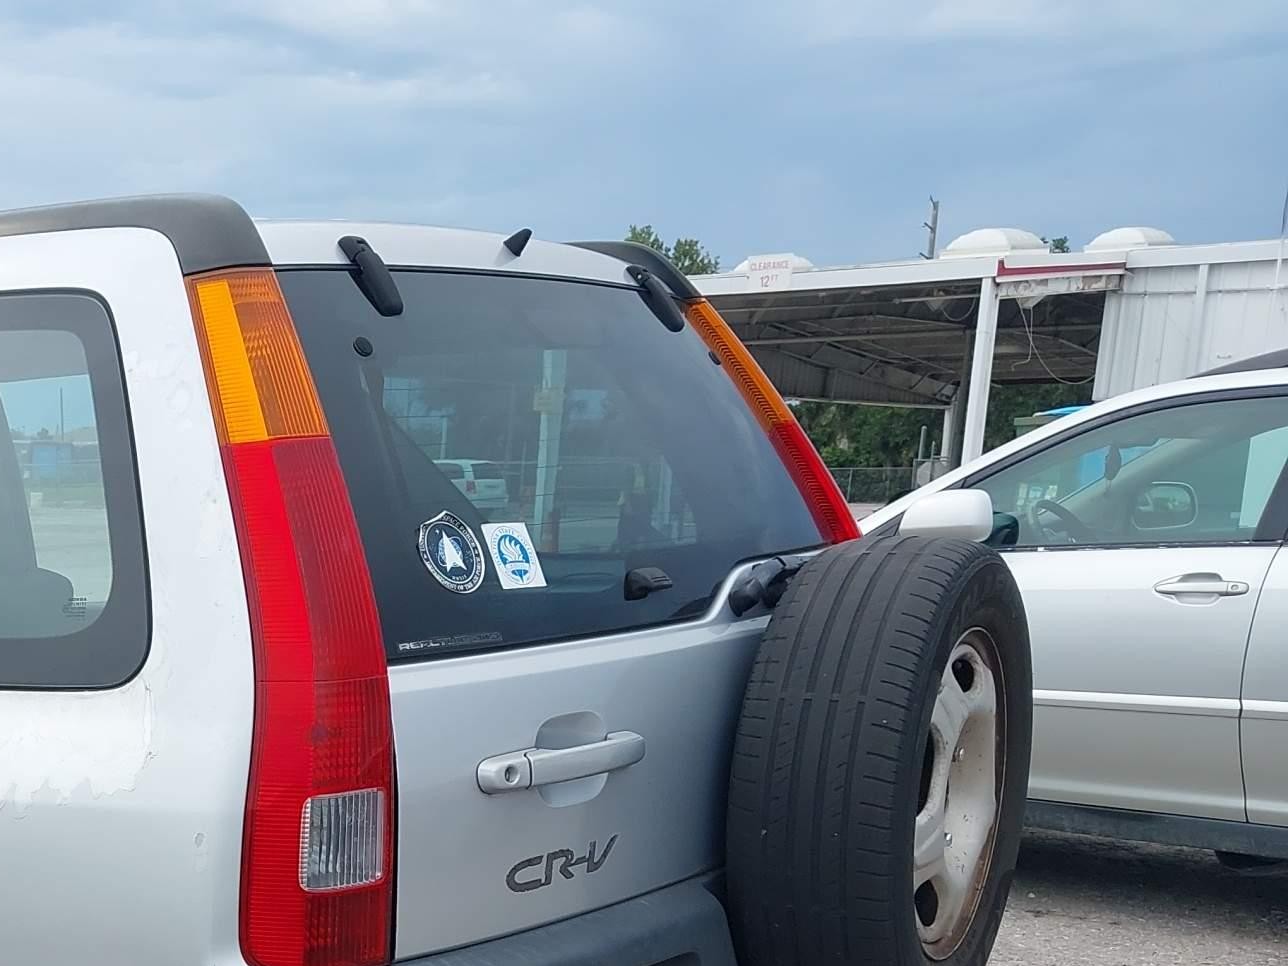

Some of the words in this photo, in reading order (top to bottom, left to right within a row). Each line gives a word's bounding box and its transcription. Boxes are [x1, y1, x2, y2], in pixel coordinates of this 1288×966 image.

[750, 260, 790, 271] CLEARANCE
[760, 274, 770, 288] 12
[443, 514, 460, 528] SPACE
[459, 525, 477, 549] FORCE
[505, 834, 619, 893] CR-V
